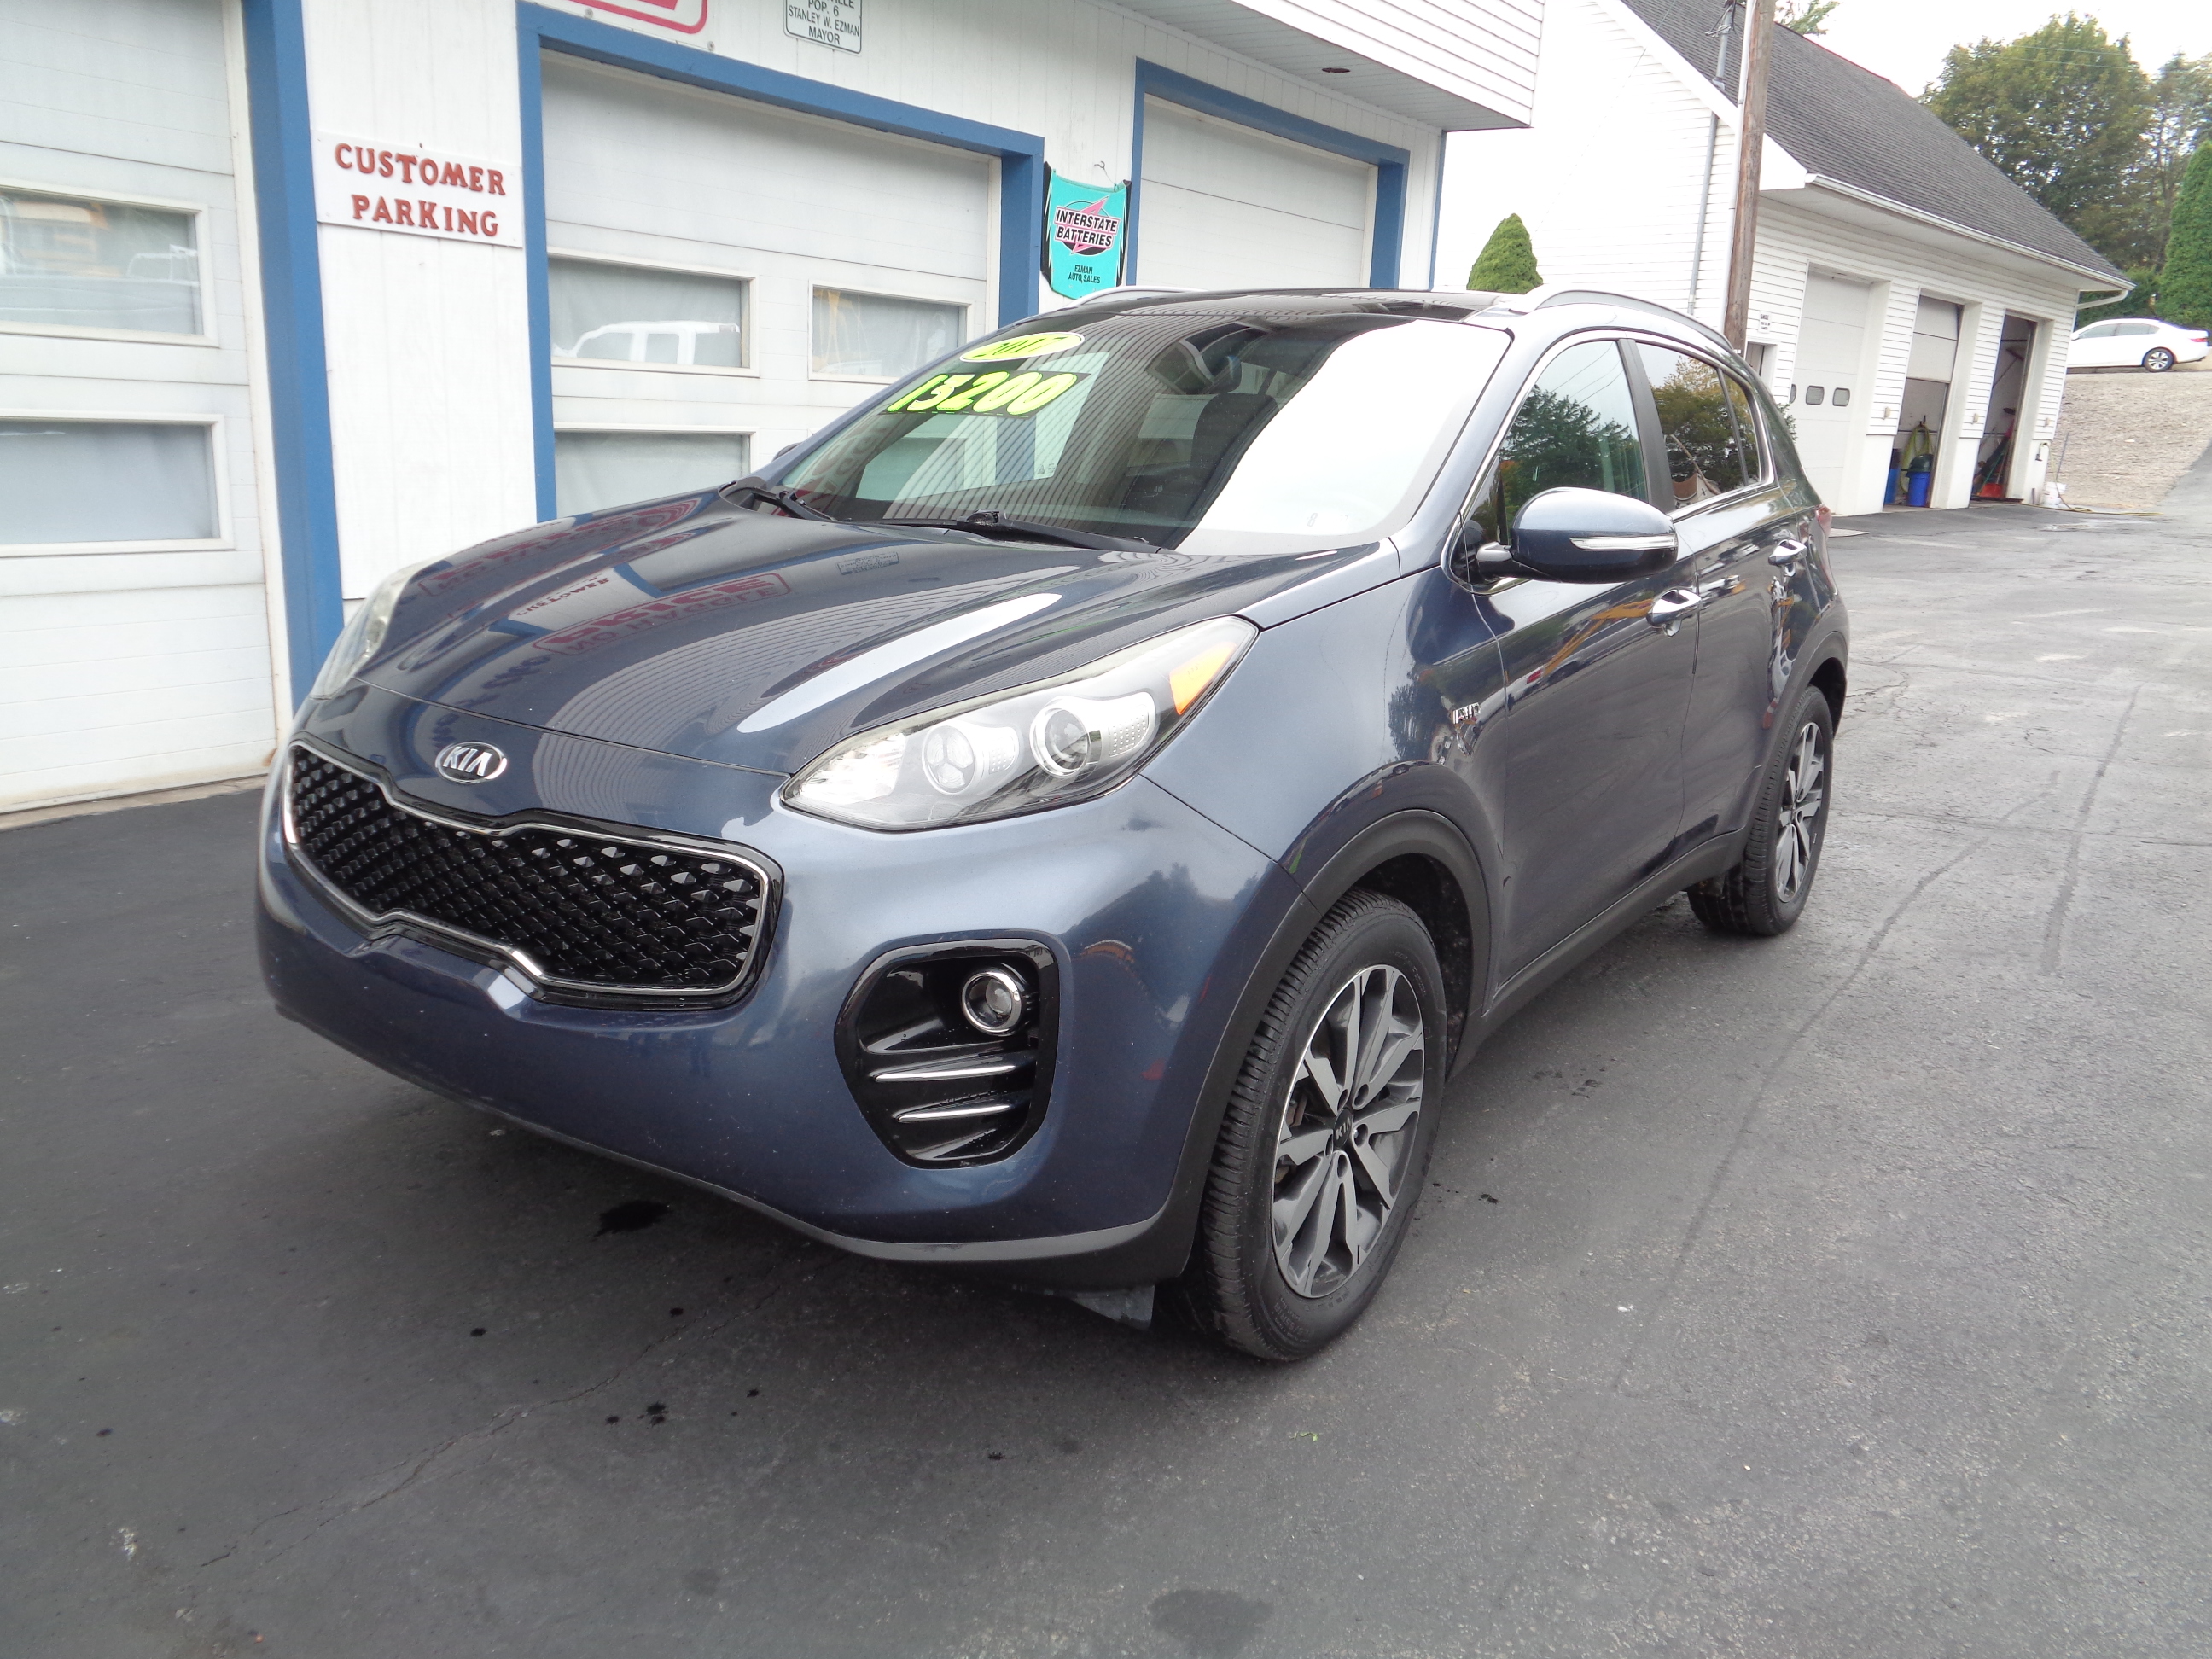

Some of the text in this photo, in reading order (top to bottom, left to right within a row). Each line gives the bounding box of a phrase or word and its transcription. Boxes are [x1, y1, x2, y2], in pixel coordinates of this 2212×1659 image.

[789, 5, 859, 37] STANLEY W. EZMAN
[833, 5, 840, 16] 6
[808, 26, 841, 45] MAYOR
[335, 143, 506, 195] CUSTOMER
[351, 194, 498, 236] PARKING
[1056, 209, 1118, 232] INTERSTATE
[1057, 226, 1113, 247] BATTERIES
[1074, 265, 1093, 275] EZMAN
[1083, 273, 1101, 284] SALES
[442, 746, 492, 777] KIA
